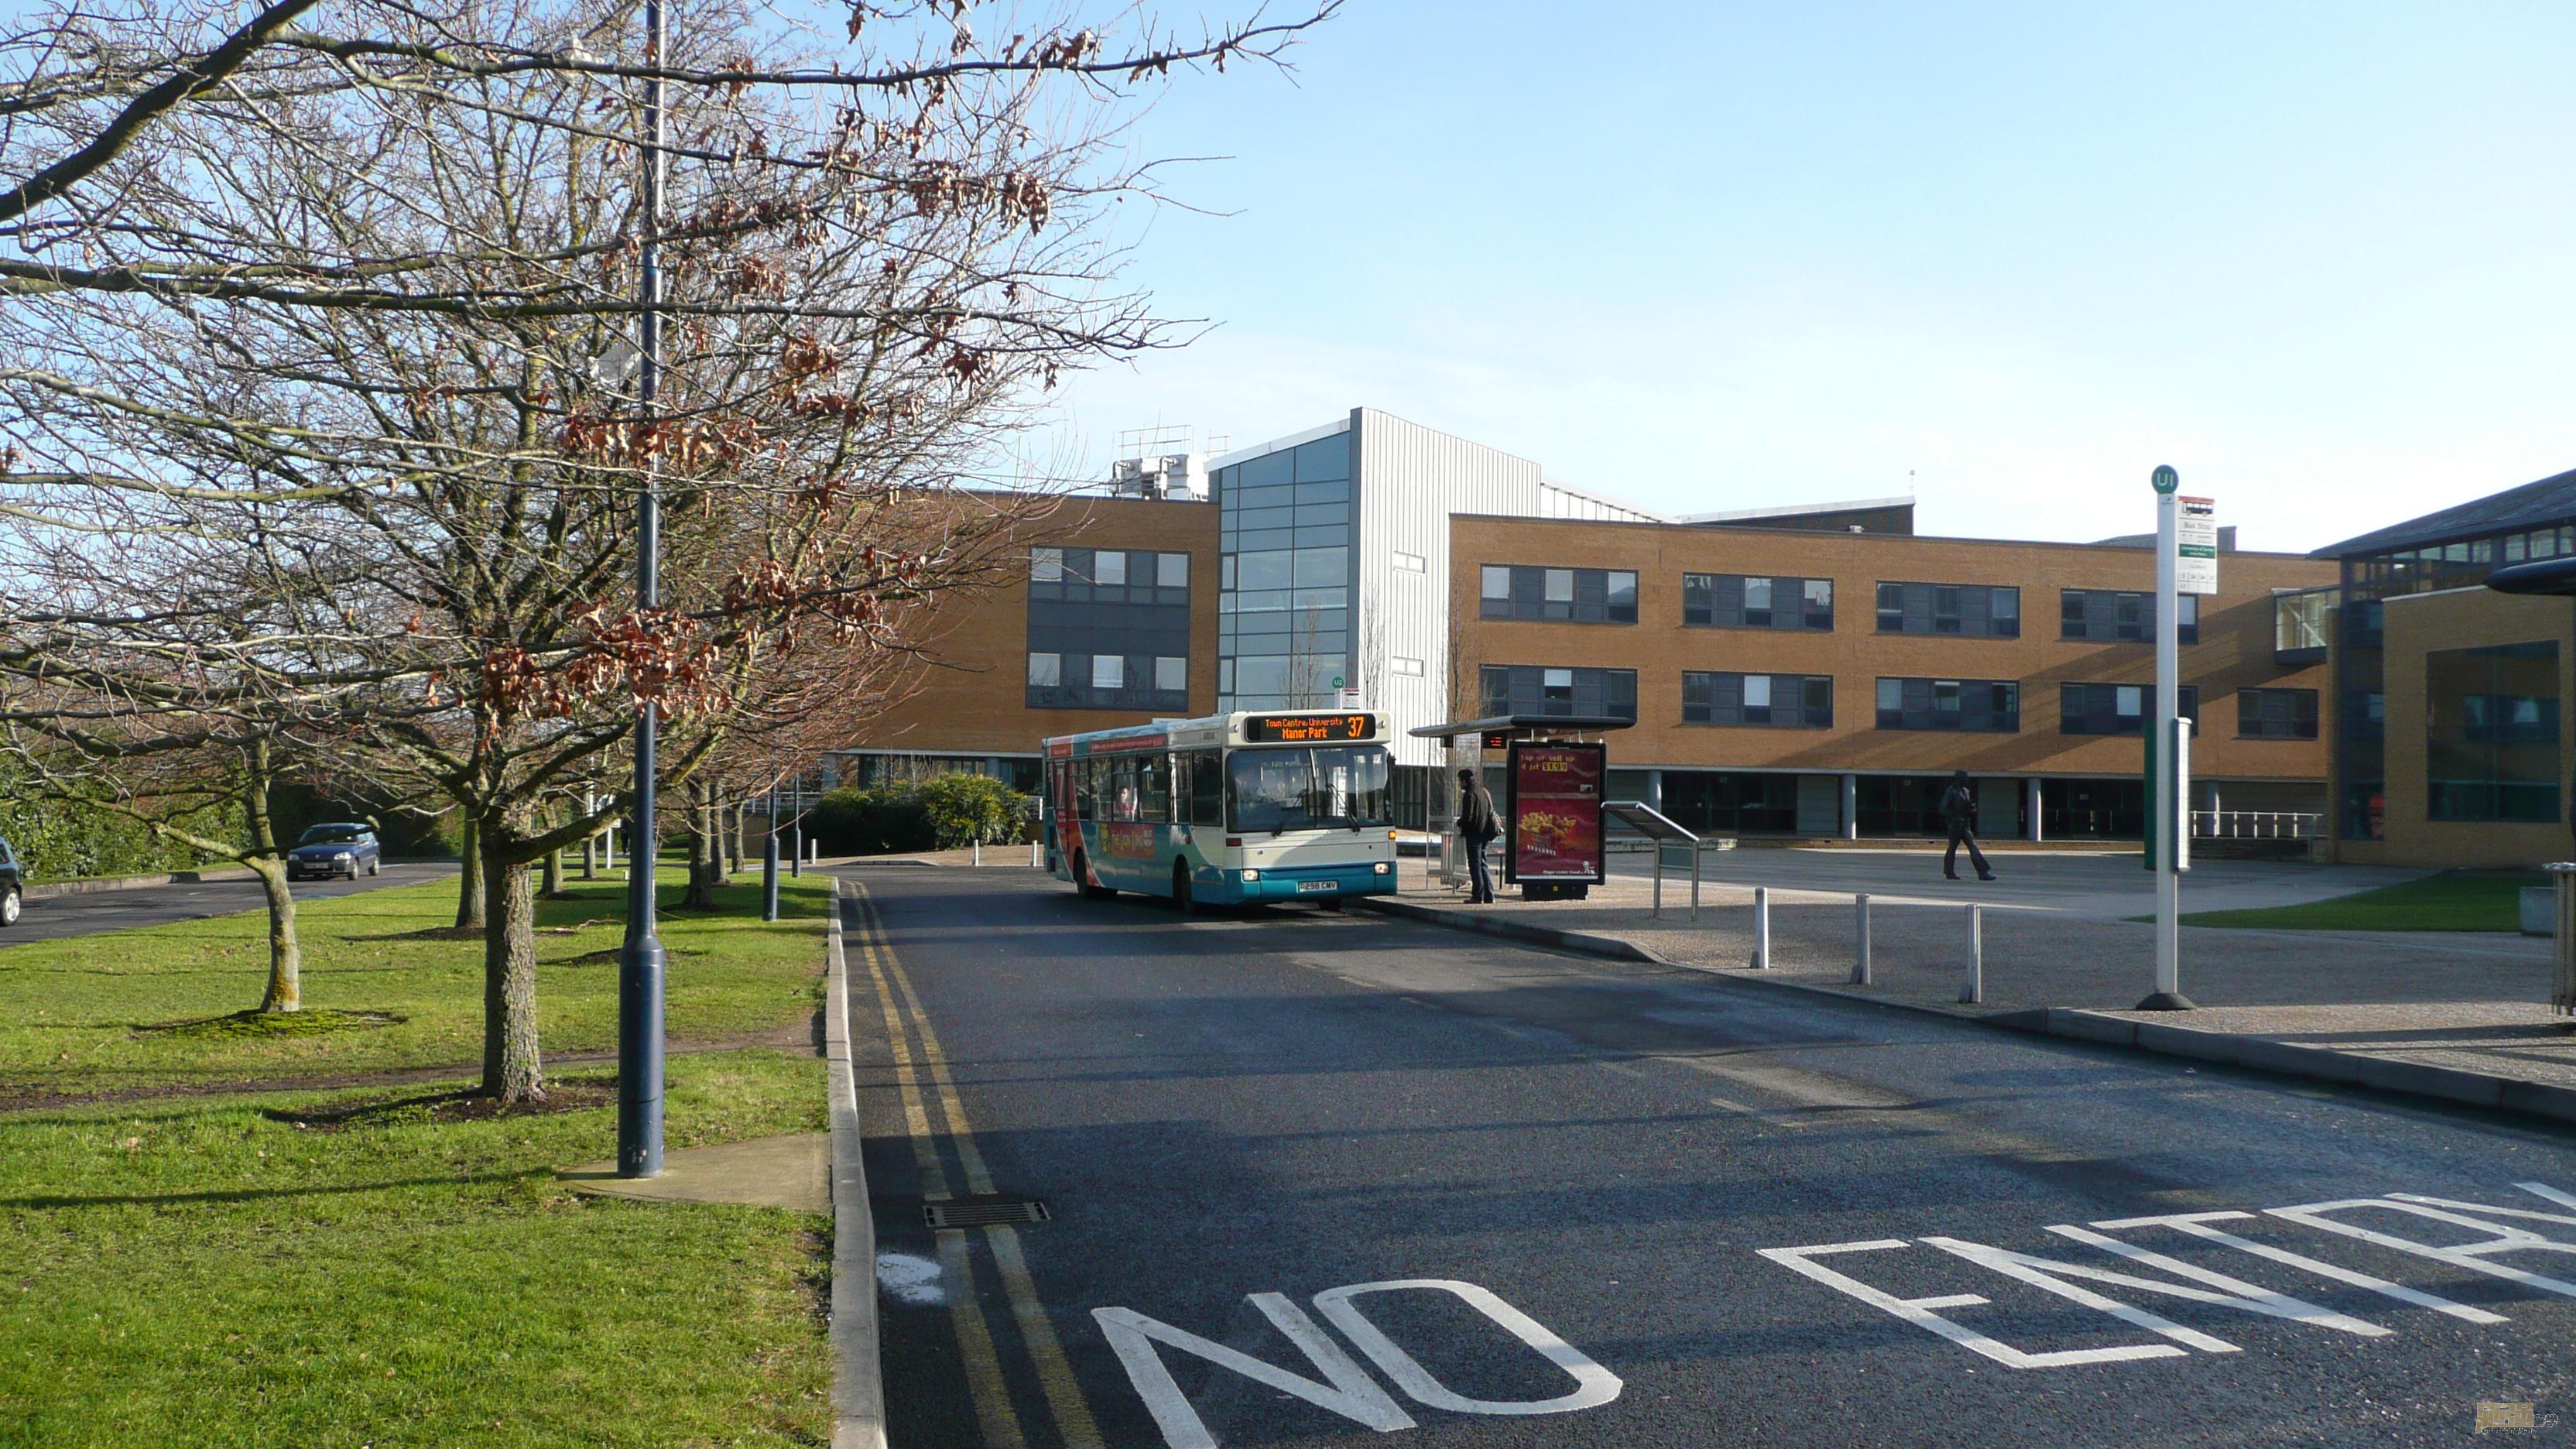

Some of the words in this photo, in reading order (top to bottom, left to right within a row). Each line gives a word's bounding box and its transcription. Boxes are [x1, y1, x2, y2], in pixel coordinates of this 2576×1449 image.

[2197, 522, 2211, 531] Stop
[1265, 718, 1283, 728] Town
[1308, 717, 1343, 727] University
[1348, 716, 1364, 738] 37
[1282, 728, 1307, 739] Manor
[1308, 727, 1327, 738] Park
[1090, 1279, 1623, 1449] NO
